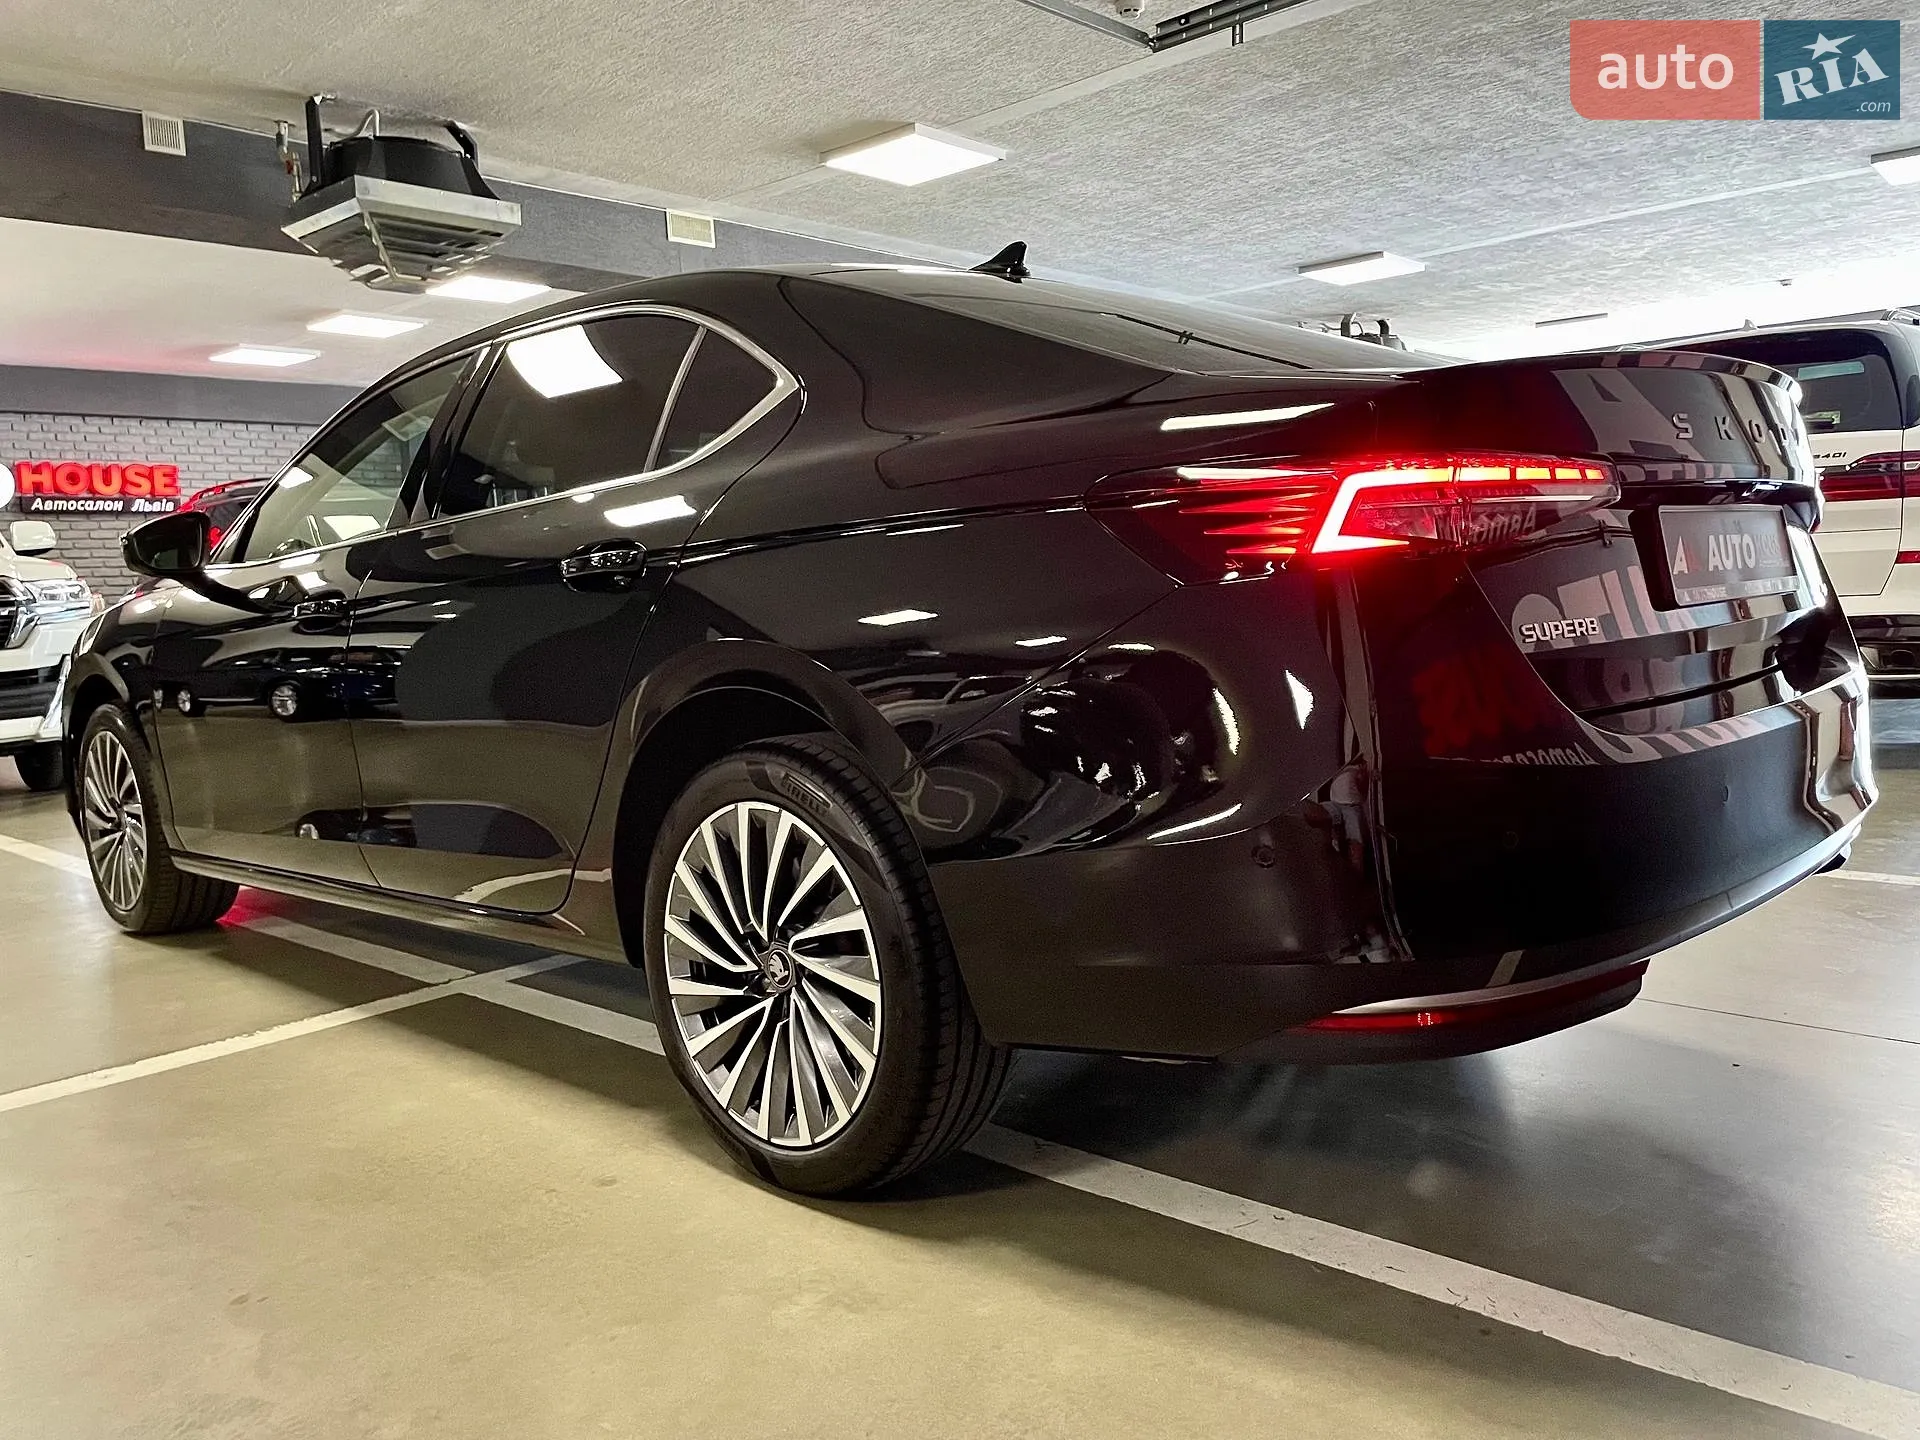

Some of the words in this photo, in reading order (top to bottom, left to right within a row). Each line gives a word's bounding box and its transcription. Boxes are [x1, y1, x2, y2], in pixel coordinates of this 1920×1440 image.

[16, 461, 179, 497] HOUSE
[31, 498, 124, 512] Автосалон
[131, 498, 175, 512] Львів
[1520, 617, 1599, 643] SUPERB
